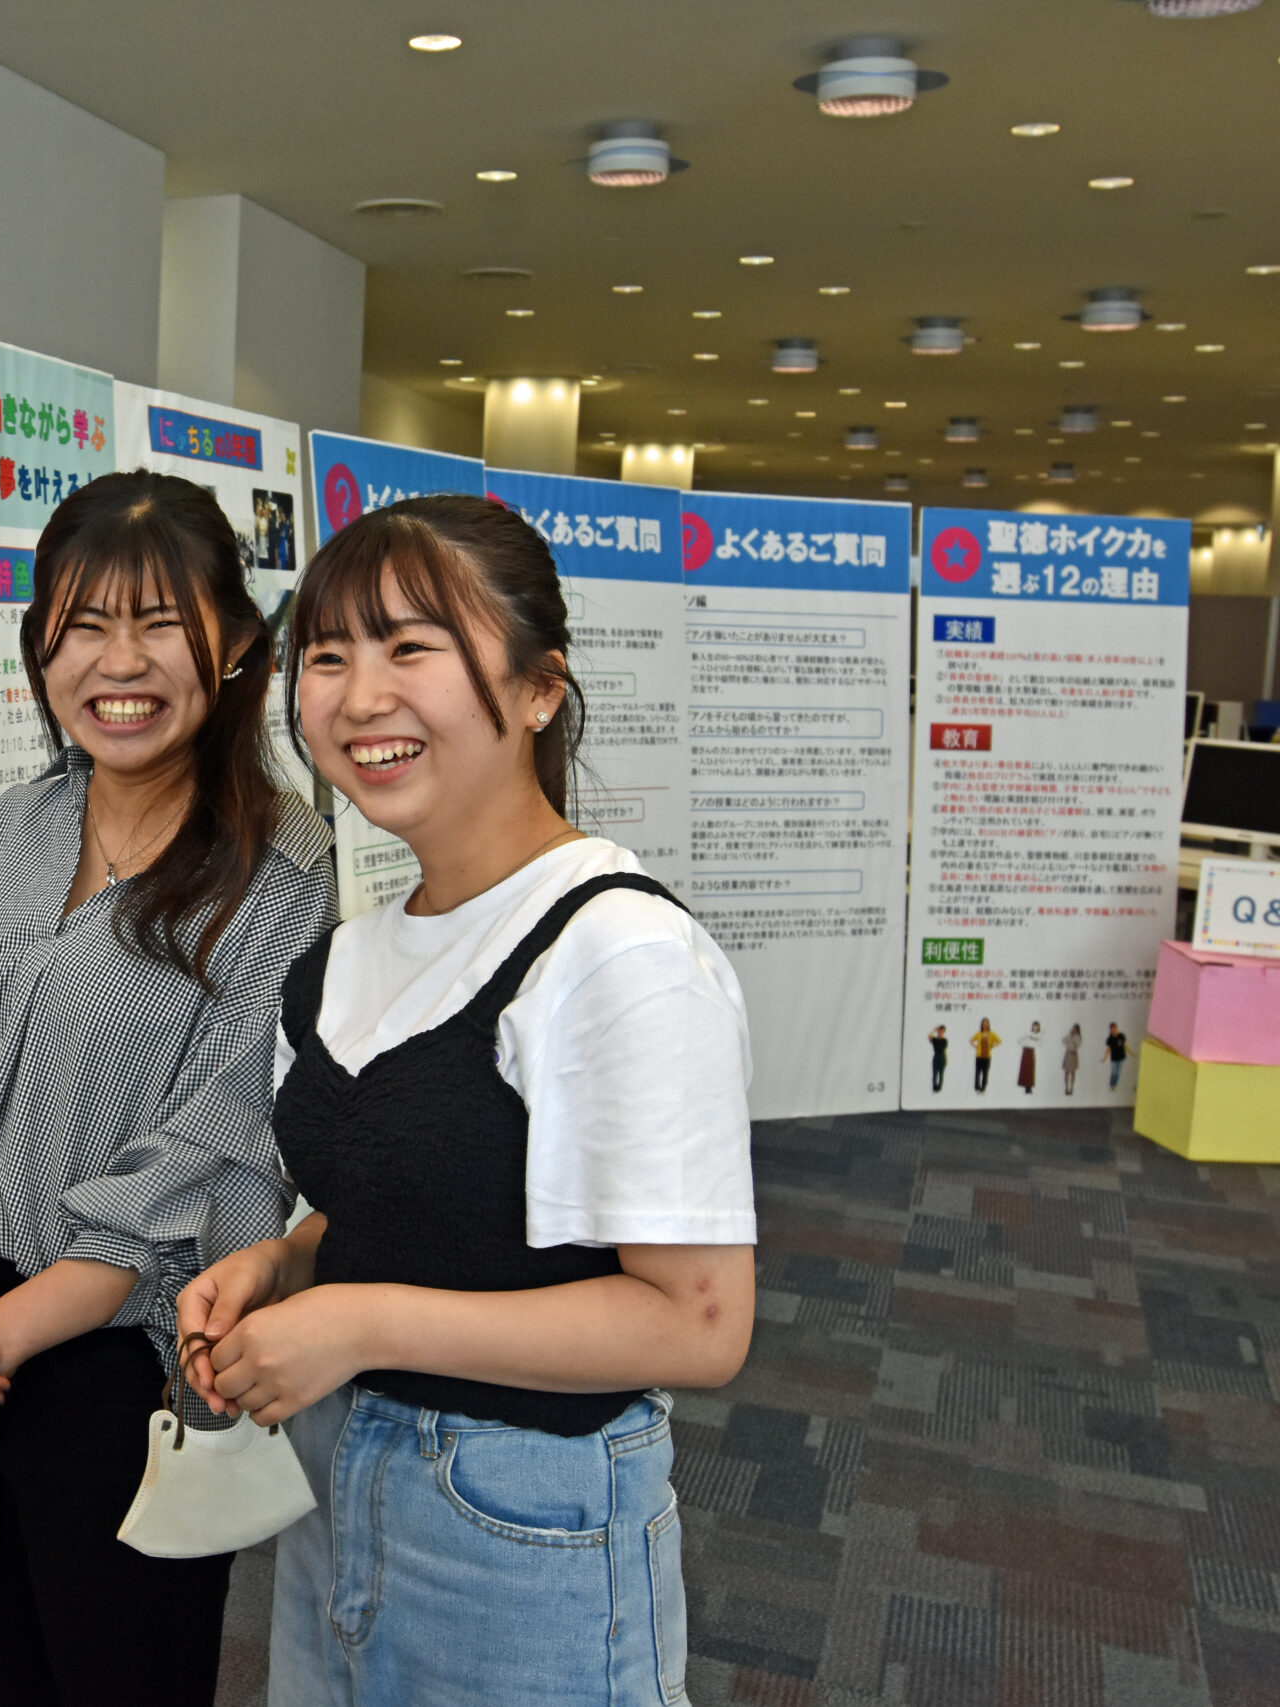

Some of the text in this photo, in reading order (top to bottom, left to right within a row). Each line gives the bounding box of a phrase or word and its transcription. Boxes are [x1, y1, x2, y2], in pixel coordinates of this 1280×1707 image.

[716, 528, 886, 567] よくあるご質問
[991, 562, 1158, 600] 選ぶ12の理由
[946, 620, 983, 640] 実績
[942, 728, 979, 748] 教育
[925, 941, 979, 960] 利便性
